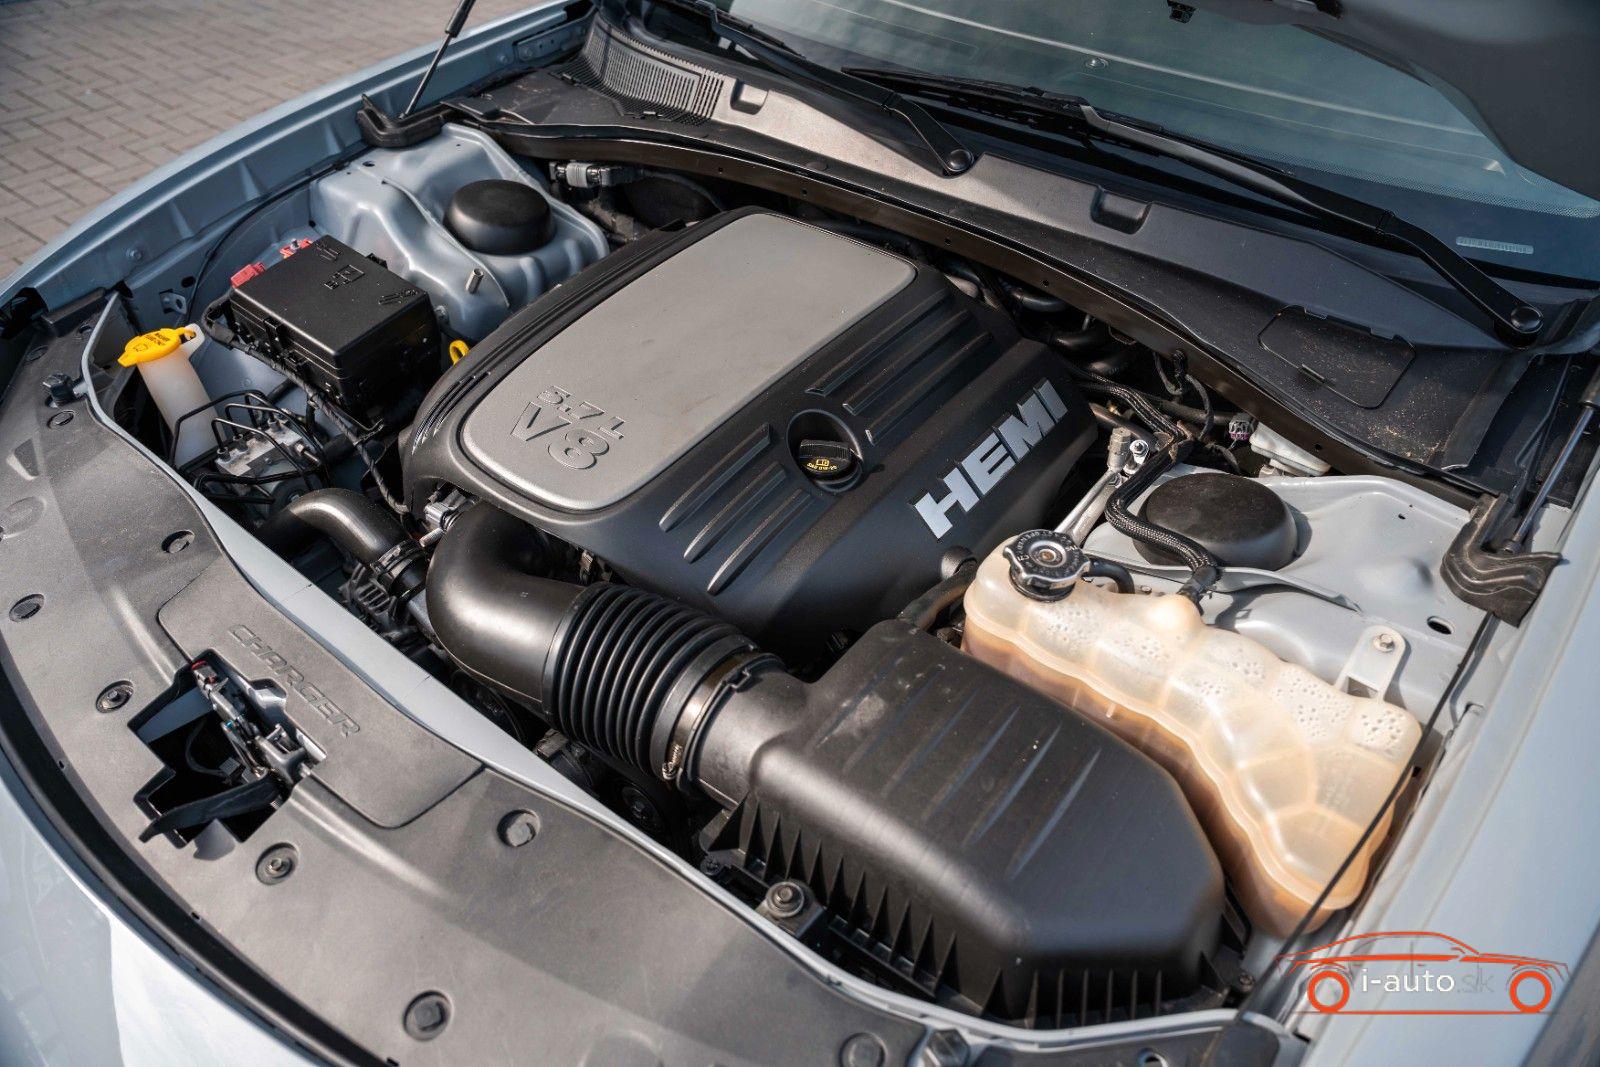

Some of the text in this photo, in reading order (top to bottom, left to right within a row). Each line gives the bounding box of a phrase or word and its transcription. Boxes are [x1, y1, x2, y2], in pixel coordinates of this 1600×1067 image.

[509, 401, 610, 470] V8
[912, 378, 1068, 540] HEMI
[228, 624, 361, 738] CHARGER
